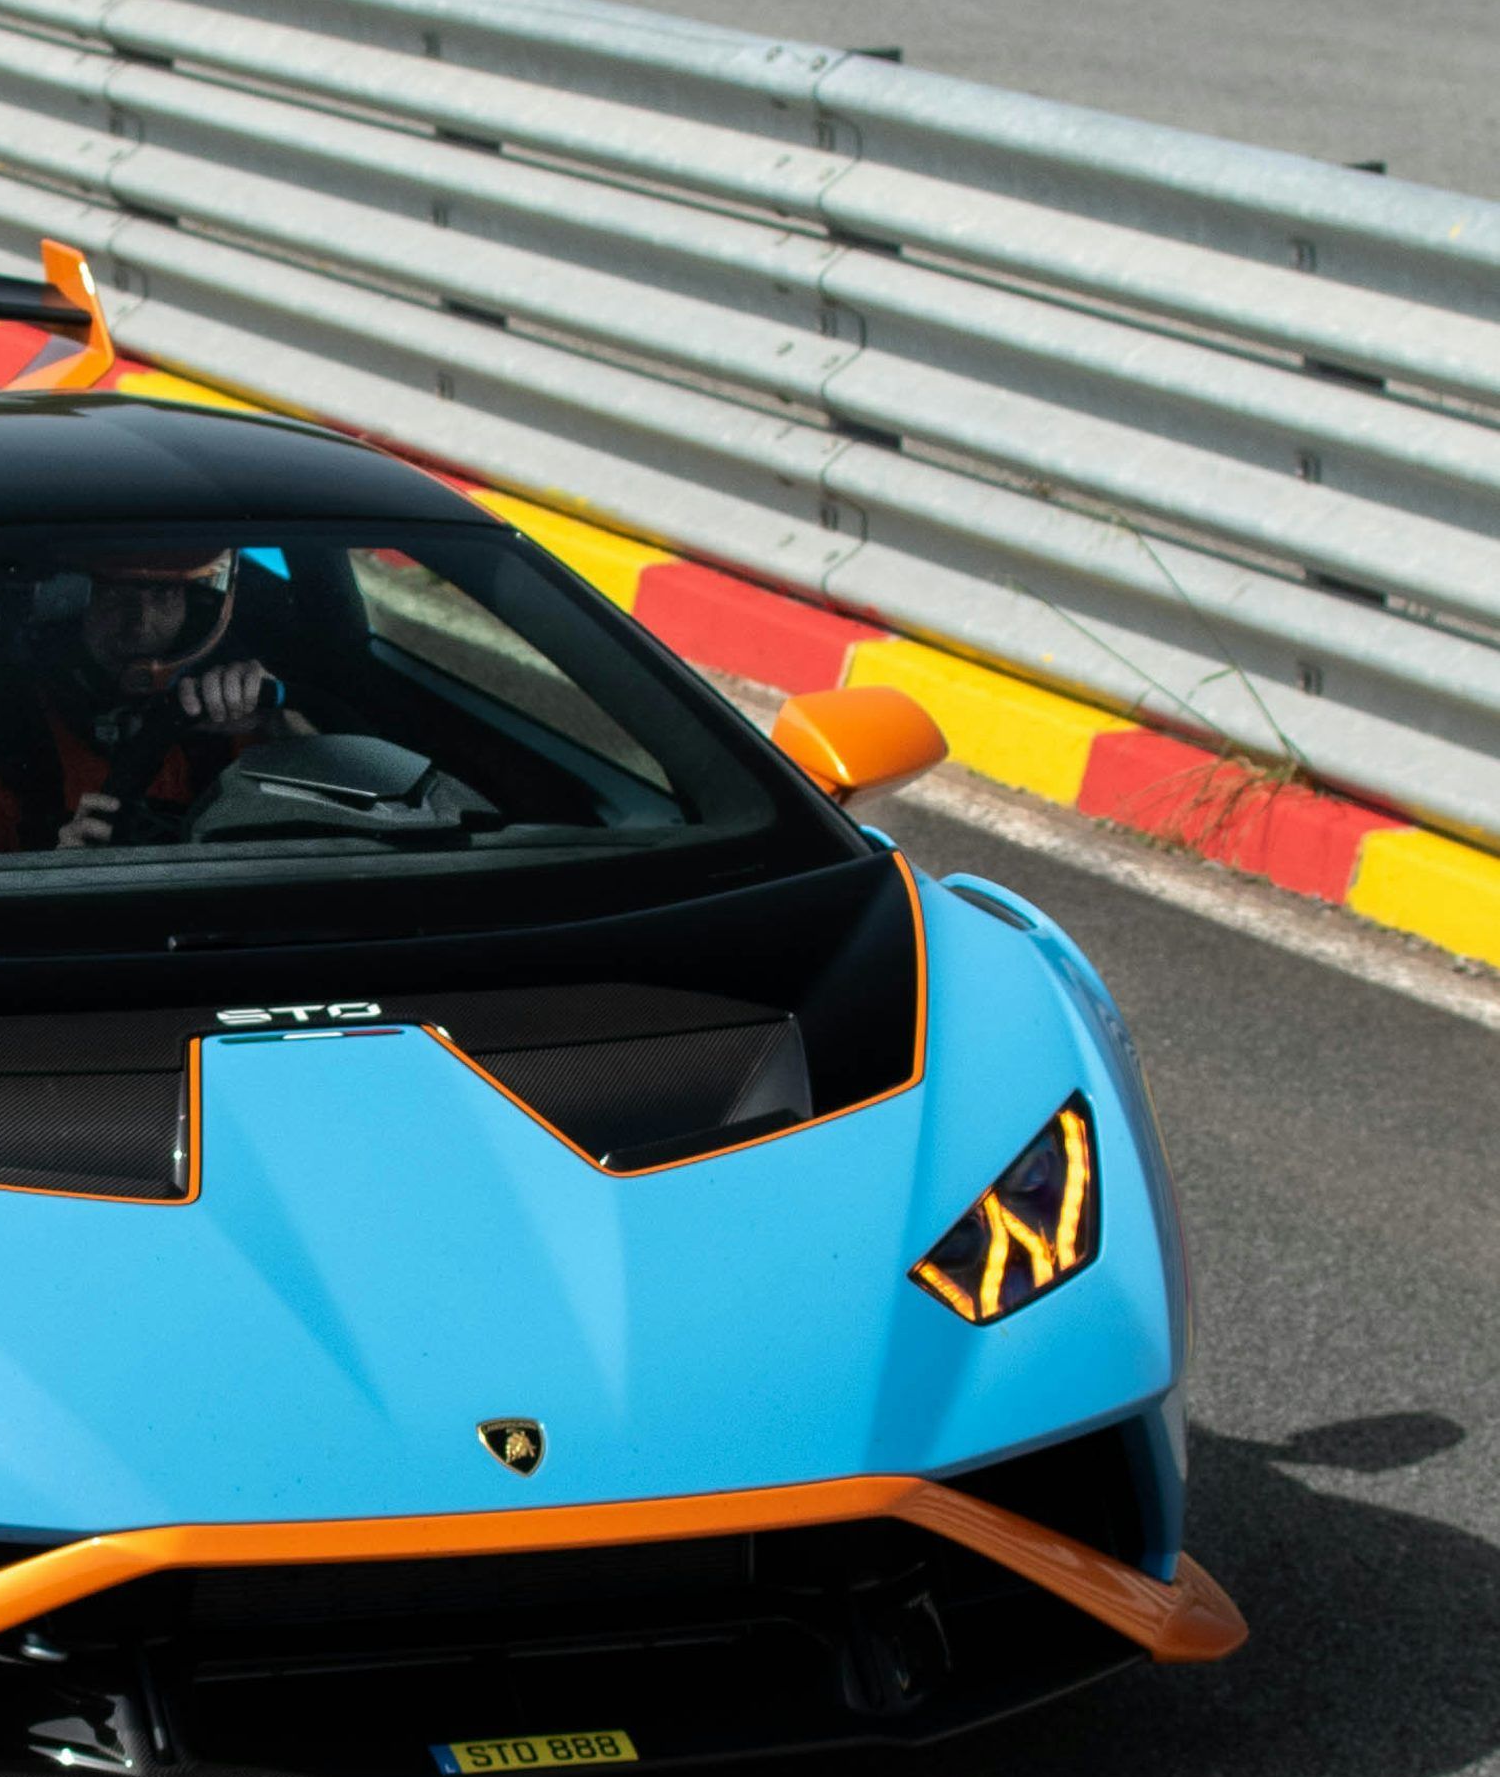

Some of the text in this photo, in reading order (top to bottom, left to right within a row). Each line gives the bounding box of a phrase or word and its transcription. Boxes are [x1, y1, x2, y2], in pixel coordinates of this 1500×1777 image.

[216, 1002, 382, 1026] STO
[465, 1735, 621, 1767] STO 888
